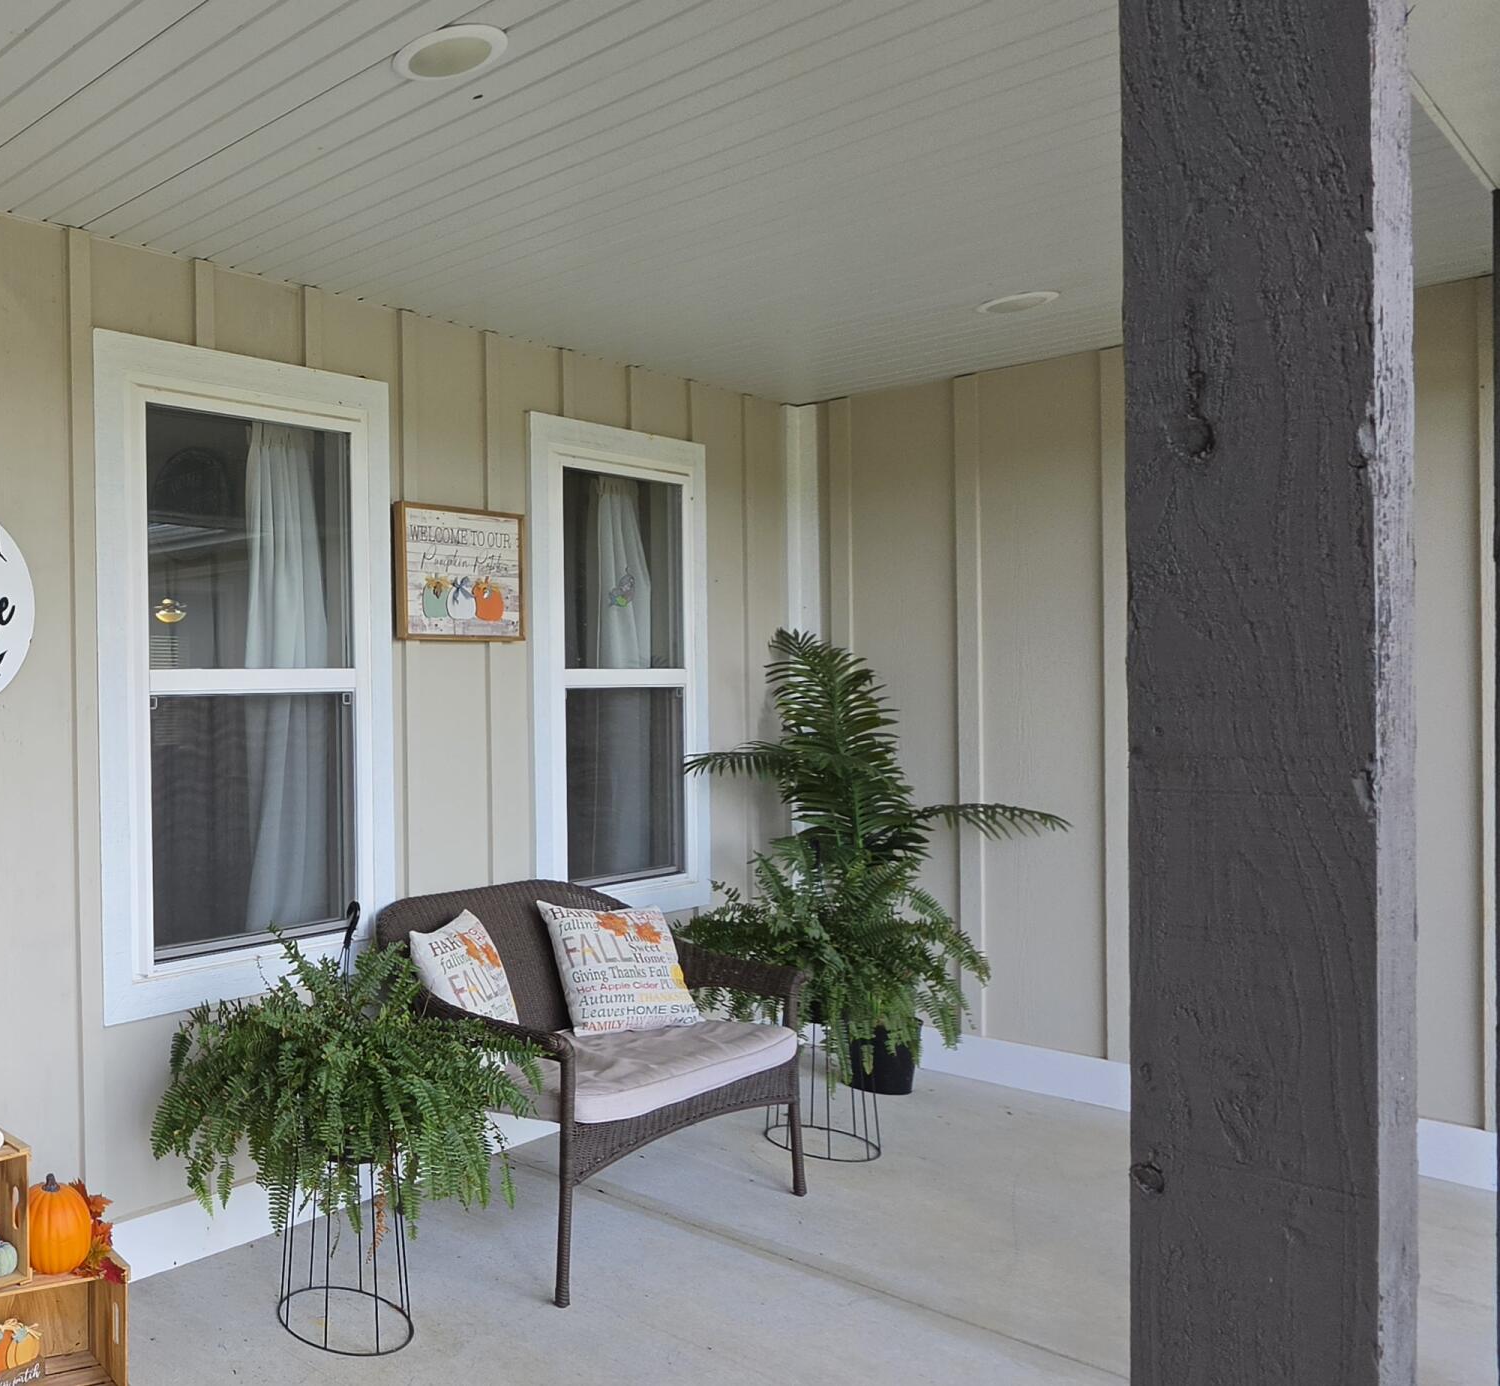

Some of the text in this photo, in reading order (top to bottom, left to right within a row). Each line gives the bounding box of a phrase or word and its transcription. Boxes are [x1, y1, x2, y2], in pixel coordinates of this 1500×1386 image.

[409, 524, 511, 549] WELCOME TO OUR
[420, 545, 470, 573] Pumpkin
[559, 919, 601, 936] falling
[562, 932, 632, 968] FALL
[628, 942, 661, 953] Sweet
[632, 952, 667, 964] Home
[572, 963, 670, 984] Giving Thanks Fall
[448, 967, 499, 1010] FALL
[576, 983, 597, 994] Hot
[600, 981, 631, 993] Apple
[632, 980, 659, 990] Cider
[579, 993, 635, 1007] Autumn
[581, 1006, 626, 1019] Leaves
[626, 1005, 667, 1015] HOME
[581, 1019, 625, 1032] FAMILY
